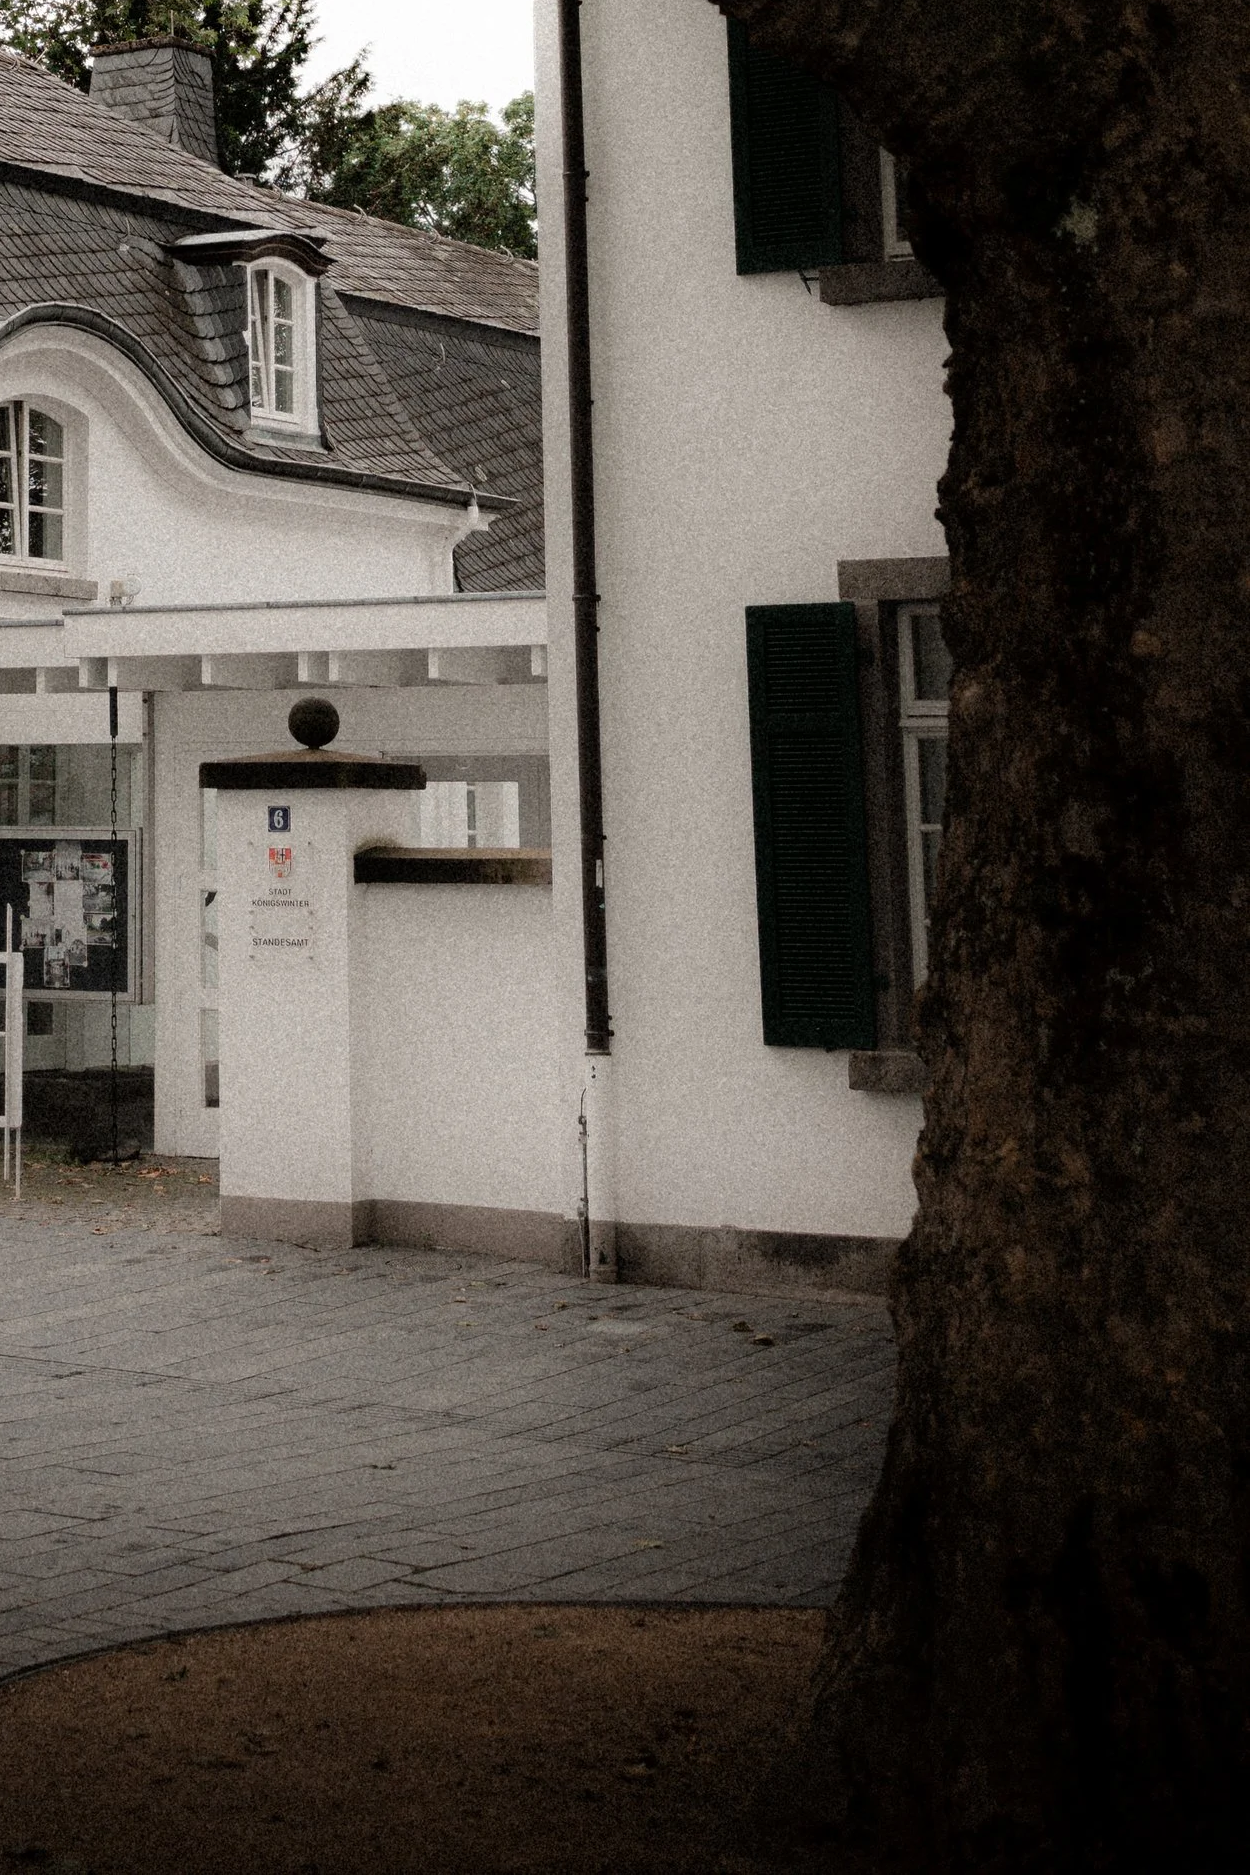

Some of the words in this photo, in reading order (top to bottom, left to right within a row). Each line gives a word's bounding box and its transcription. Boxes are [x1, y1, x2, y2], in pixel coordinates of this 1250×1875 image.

[273, 809, 284, 829] 6
[268, 888, 292, 896] STADT
[251, 898, 310, 908] KÖNIGSWINTER
[252, 938, 309, 947] STANDESAMT
